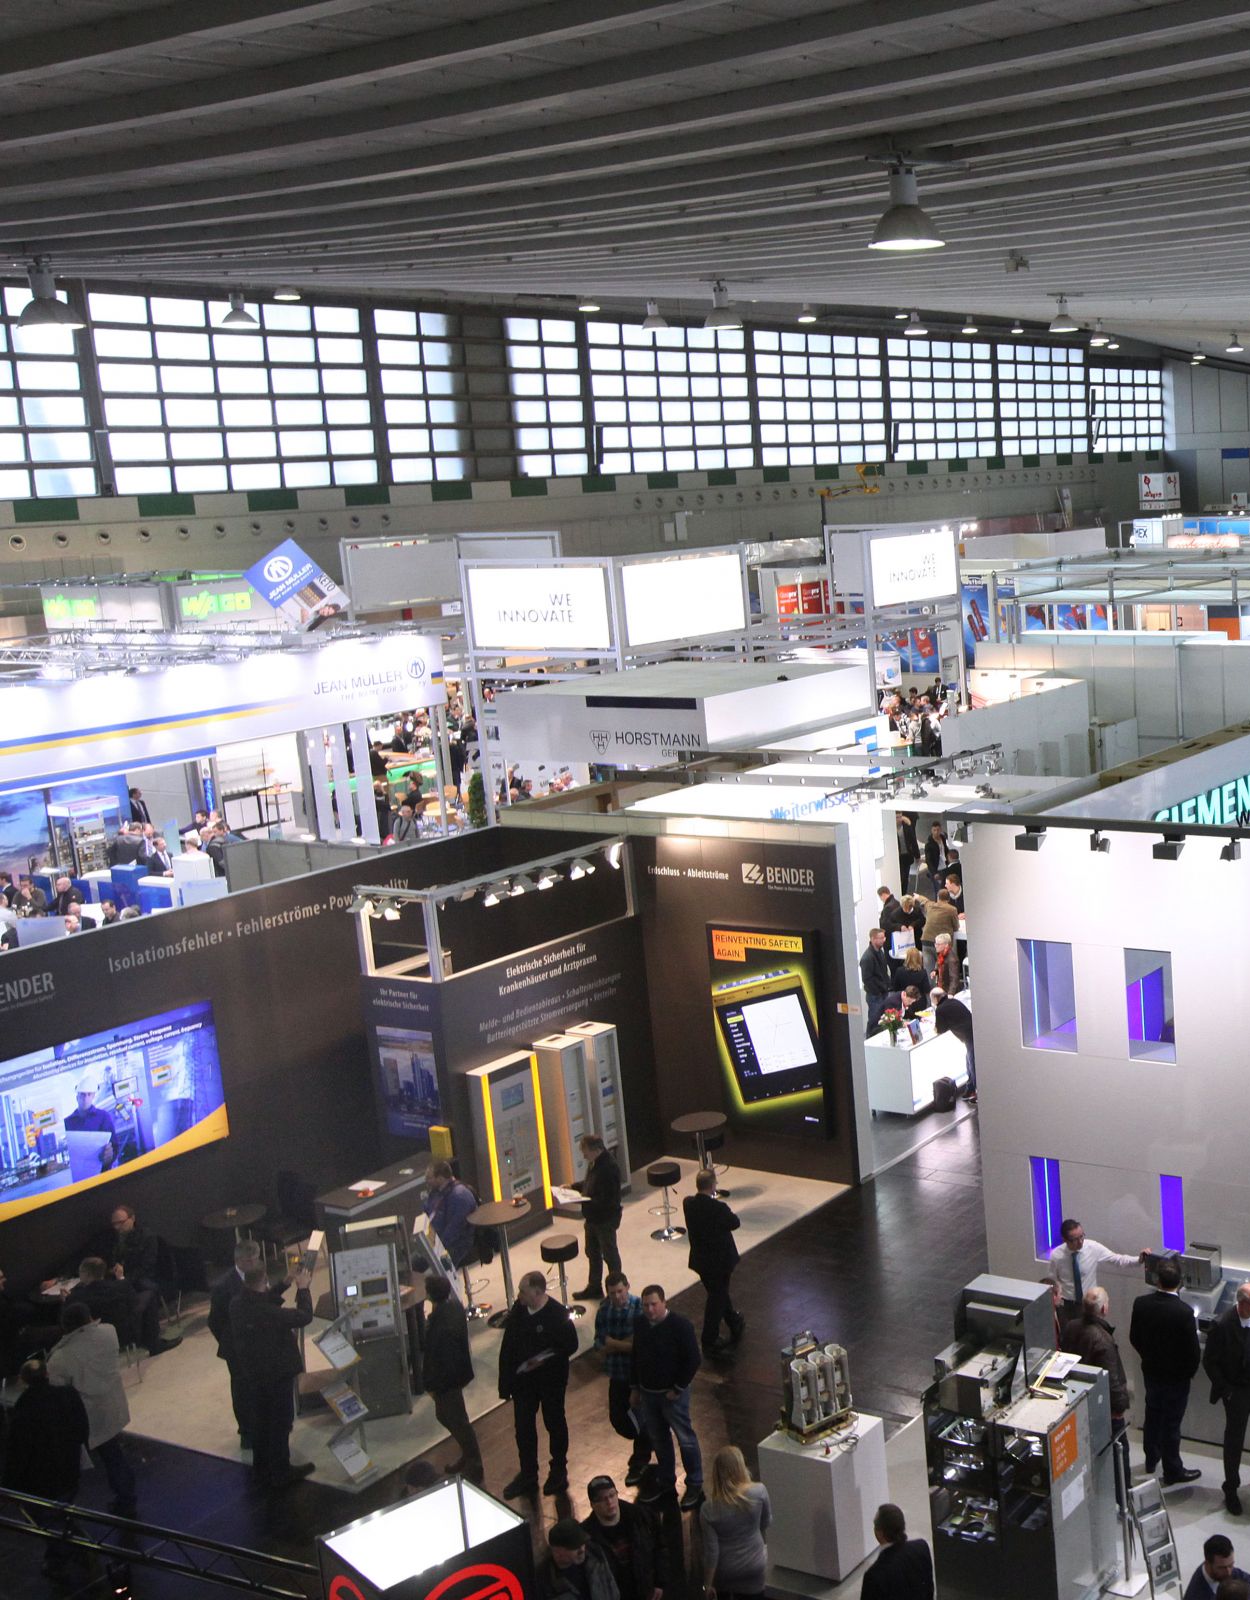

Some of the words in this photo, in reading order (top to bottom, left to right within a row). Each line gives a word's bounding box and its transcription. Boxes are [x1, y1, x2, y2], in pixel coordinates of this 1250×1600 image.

[182, 590, 252, 620] WAGO
[550, 593, 572, 606] WE
[498, 609, 575, 623] INNOVATE
[313, 680, 347, 696] JEAN
[615, 731, 701, 748] HORSTMANN
[769, 791, 851, 820] Weiterwisse
[647, 865, 680, 877] Erdschluss
[687, 868, 729, 880] Ableitströme
[766, 866, 815, 887] BENDER
[108, 928, 225, 974] Isolationsfehler
[236, 903, 321, 938] Fehlerströme
[329, 893, 353, 910] Pow
[506, 958, 543, 978] Elektrische
[543, 946, 576, 965] Sicherheit
[576, 943, 587, 954] für
[498, 971, 548, 998] Krankenhäuser
[549, 967, 562, 978] und
[563, 954, 598, 974] Arztpraxen
